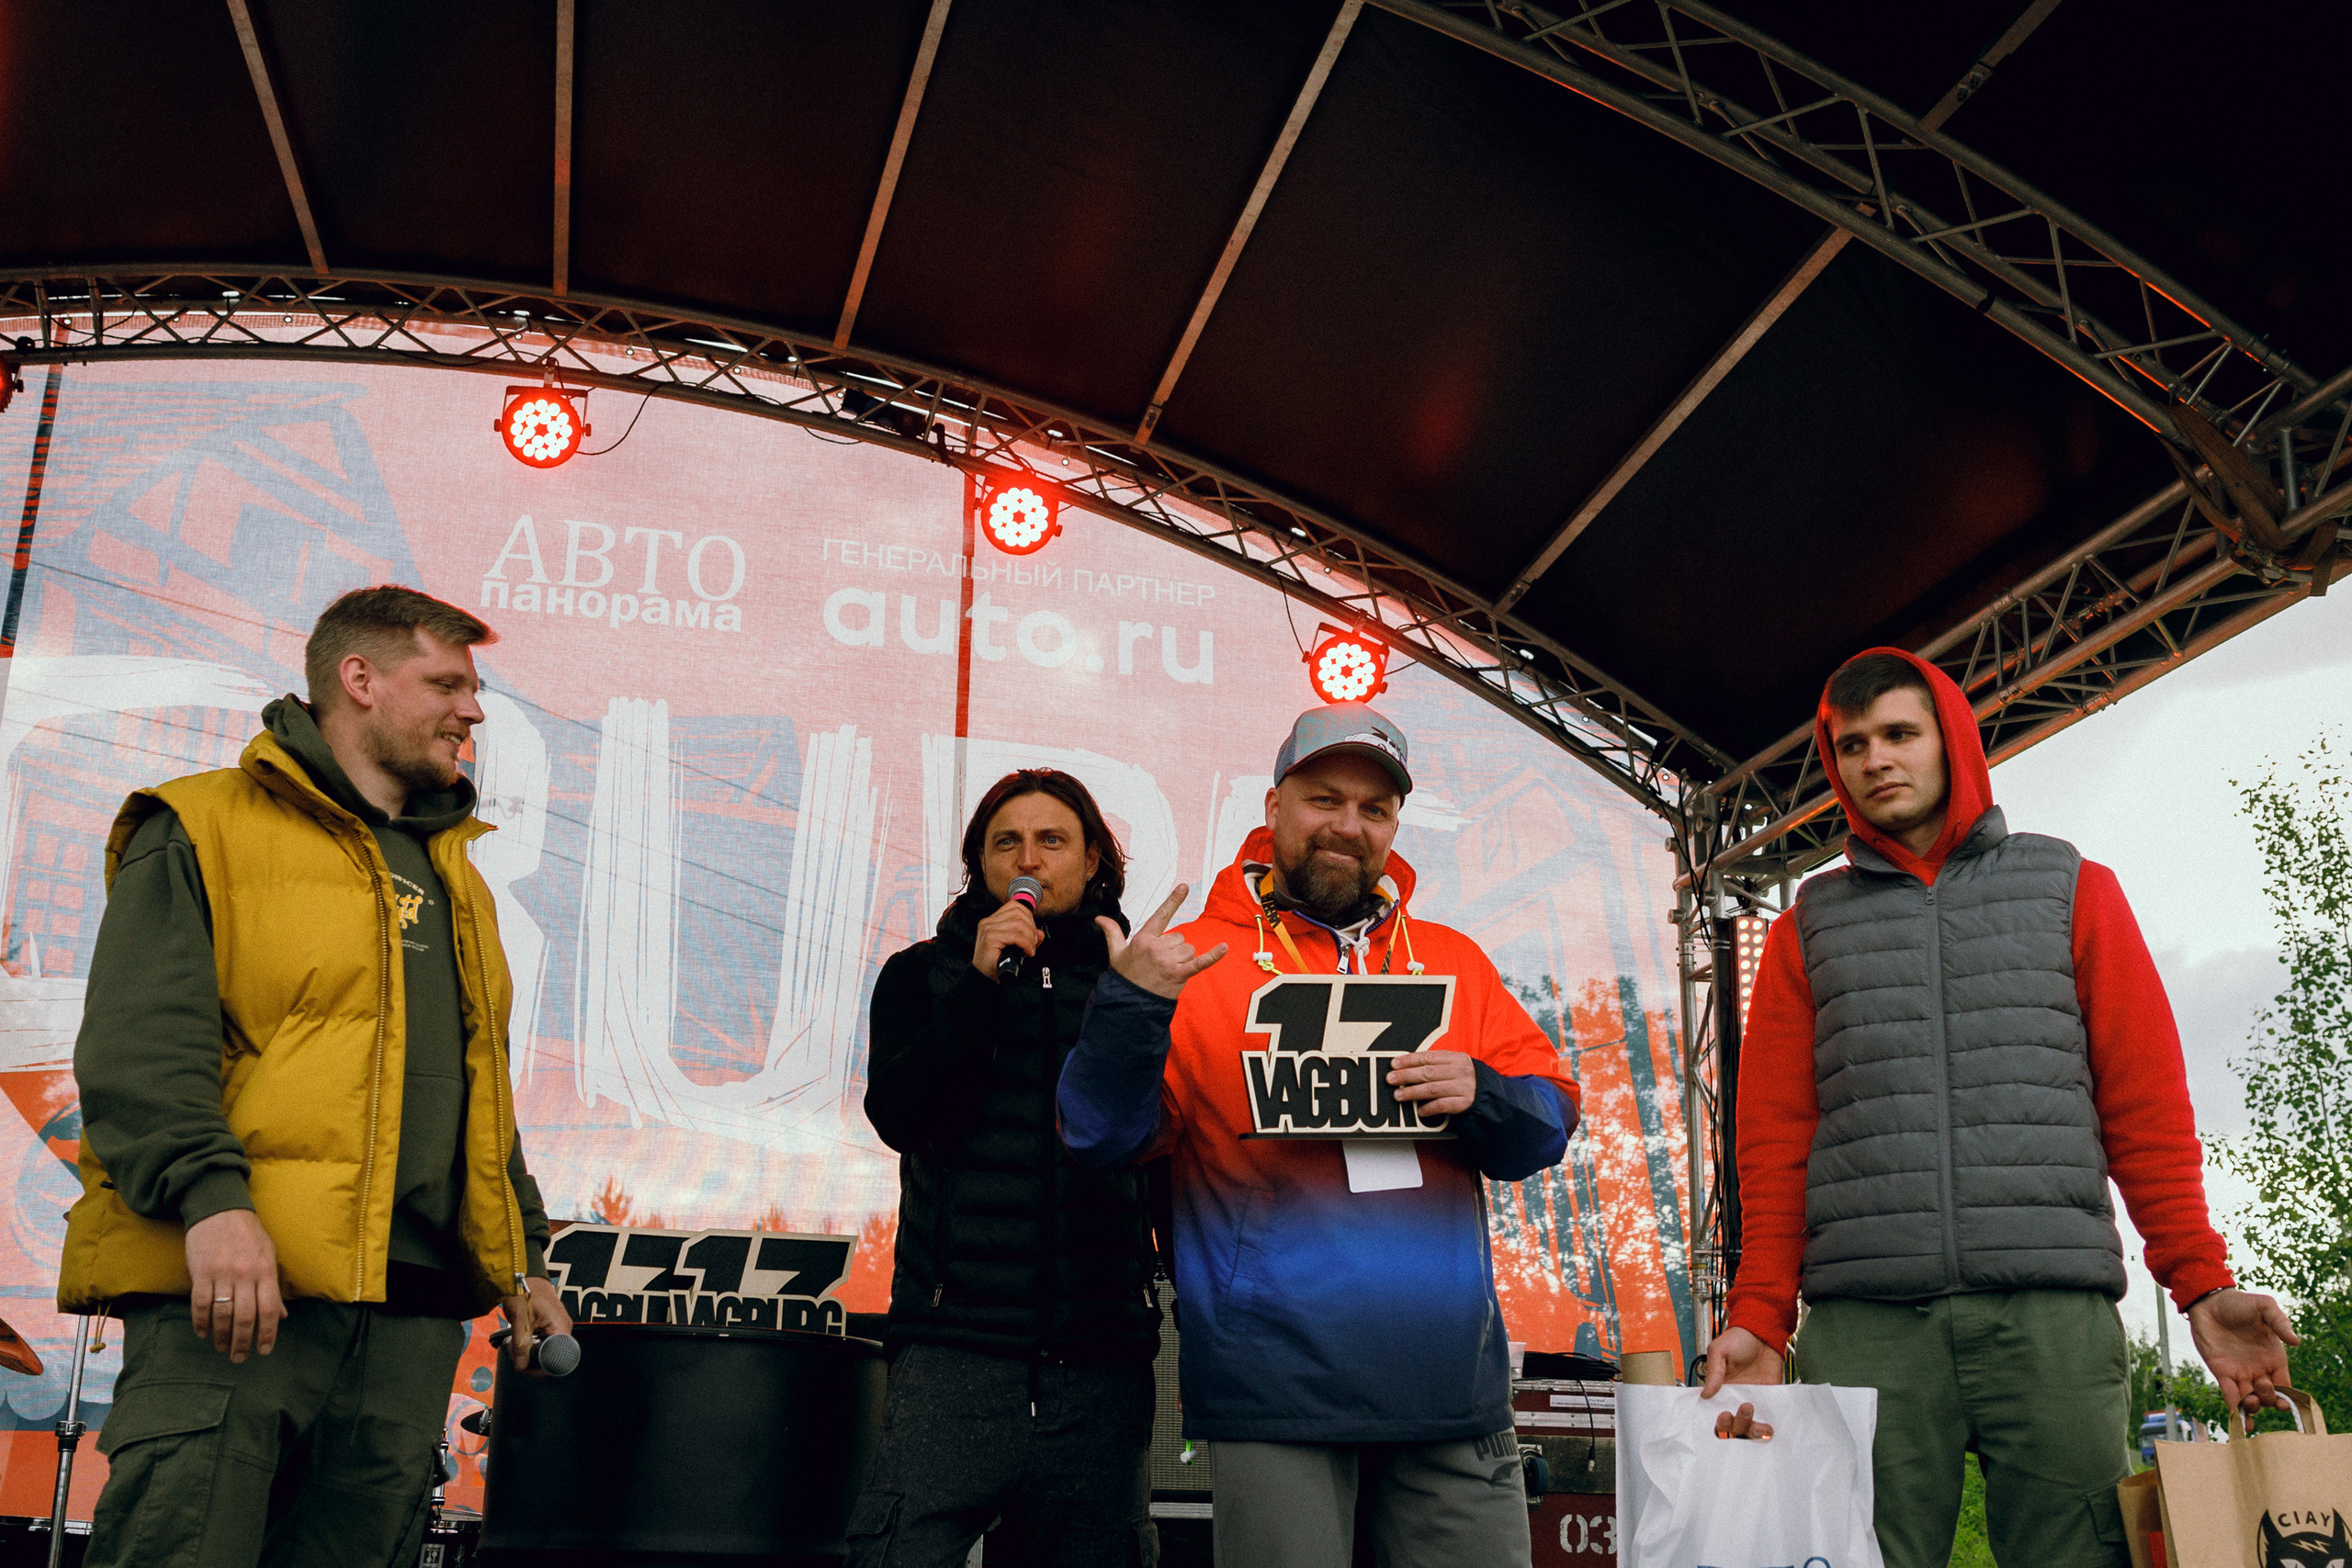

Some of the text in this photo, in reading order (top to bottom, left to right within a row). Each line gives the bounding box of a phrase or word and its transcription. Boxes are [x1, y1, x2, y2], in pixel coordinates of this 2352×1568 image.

[483, 514, 746, 602] АВТО
[823, 538, 1216, 607] ГЕНЕРАЛЬНЫЙ ПАРТНЕР
[480, 580, 742, 633] панорама
[823, 586, 1215, 685] auto.ru
[1255, 982, 1448, 1052] 17
[1246, 1054, 1450, 1130] VAGBU
[548, 1229, 692, 1292] 17
[682, 1235, 852, 1299] 17
